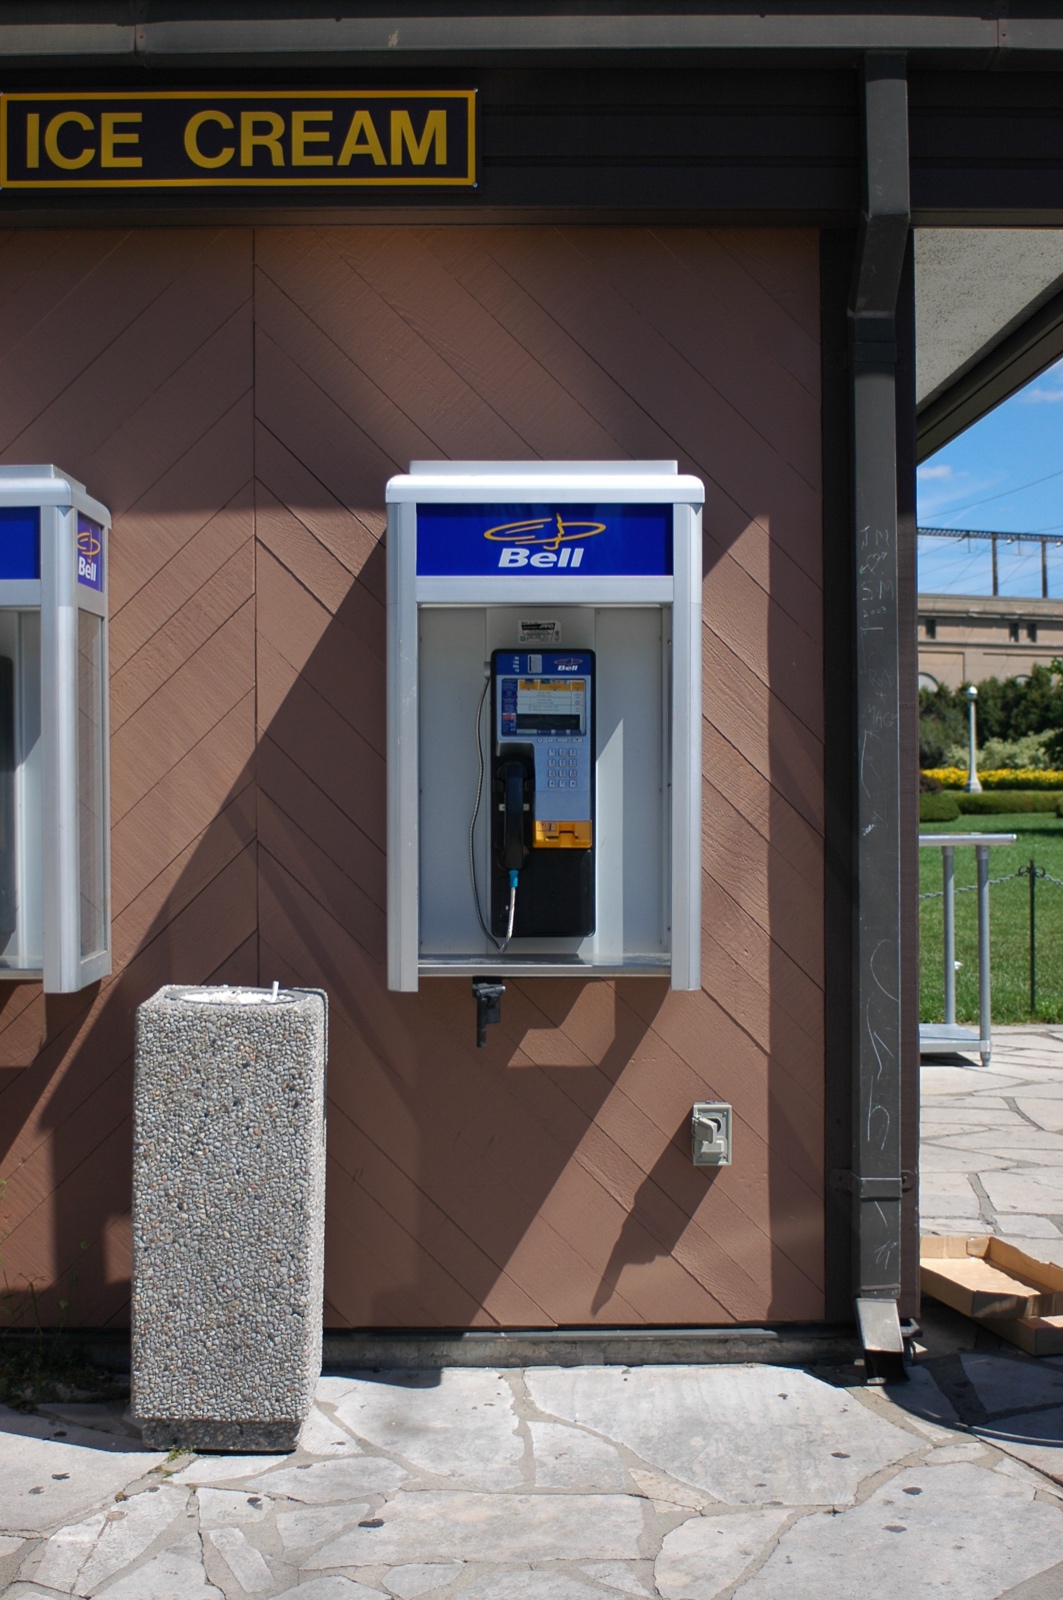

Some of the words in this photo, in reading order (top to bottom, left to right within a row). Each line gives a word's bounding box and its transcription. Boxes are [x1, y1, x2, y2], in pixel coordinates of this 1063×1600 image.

[26, 111, 143, 169] ICE
[184, 110, 447, 169] CREAM
[78, 556, 97, 581] Bell
[498, 547, 584, 568] Bell
